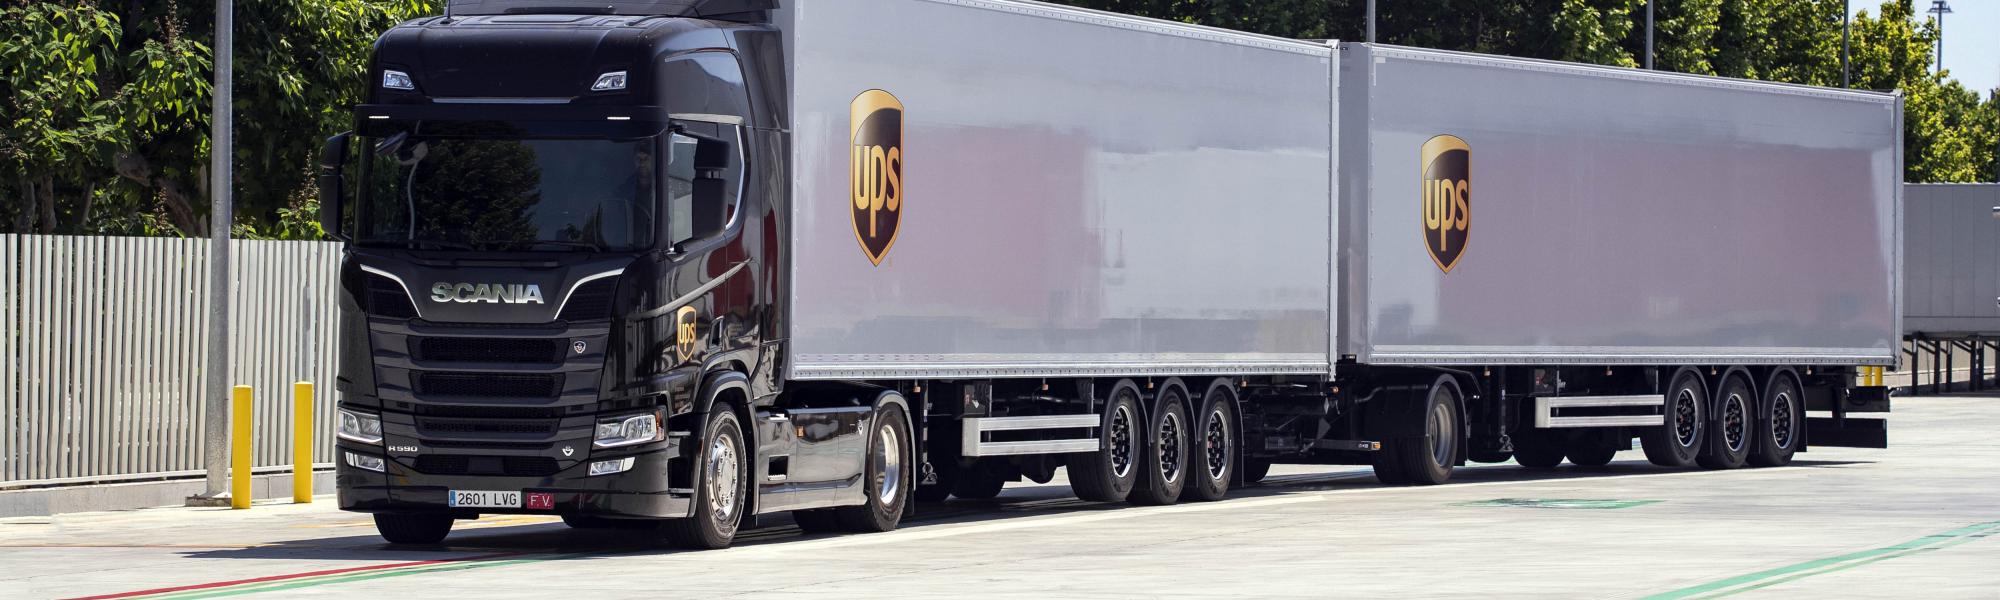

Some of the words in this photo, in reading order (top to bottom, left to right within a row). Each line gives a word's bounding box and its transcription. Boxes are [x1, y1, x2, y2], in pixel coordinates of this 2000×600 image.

[854, 144, 900, 238] ups
[1425, 178, 1468, 252] ups
[430, 281, 544, 304] SCANIA
[679, 322, 695, 352] ups
[458, 493, 487, 505] 2601
[494, 493, 517, 505] LVG
